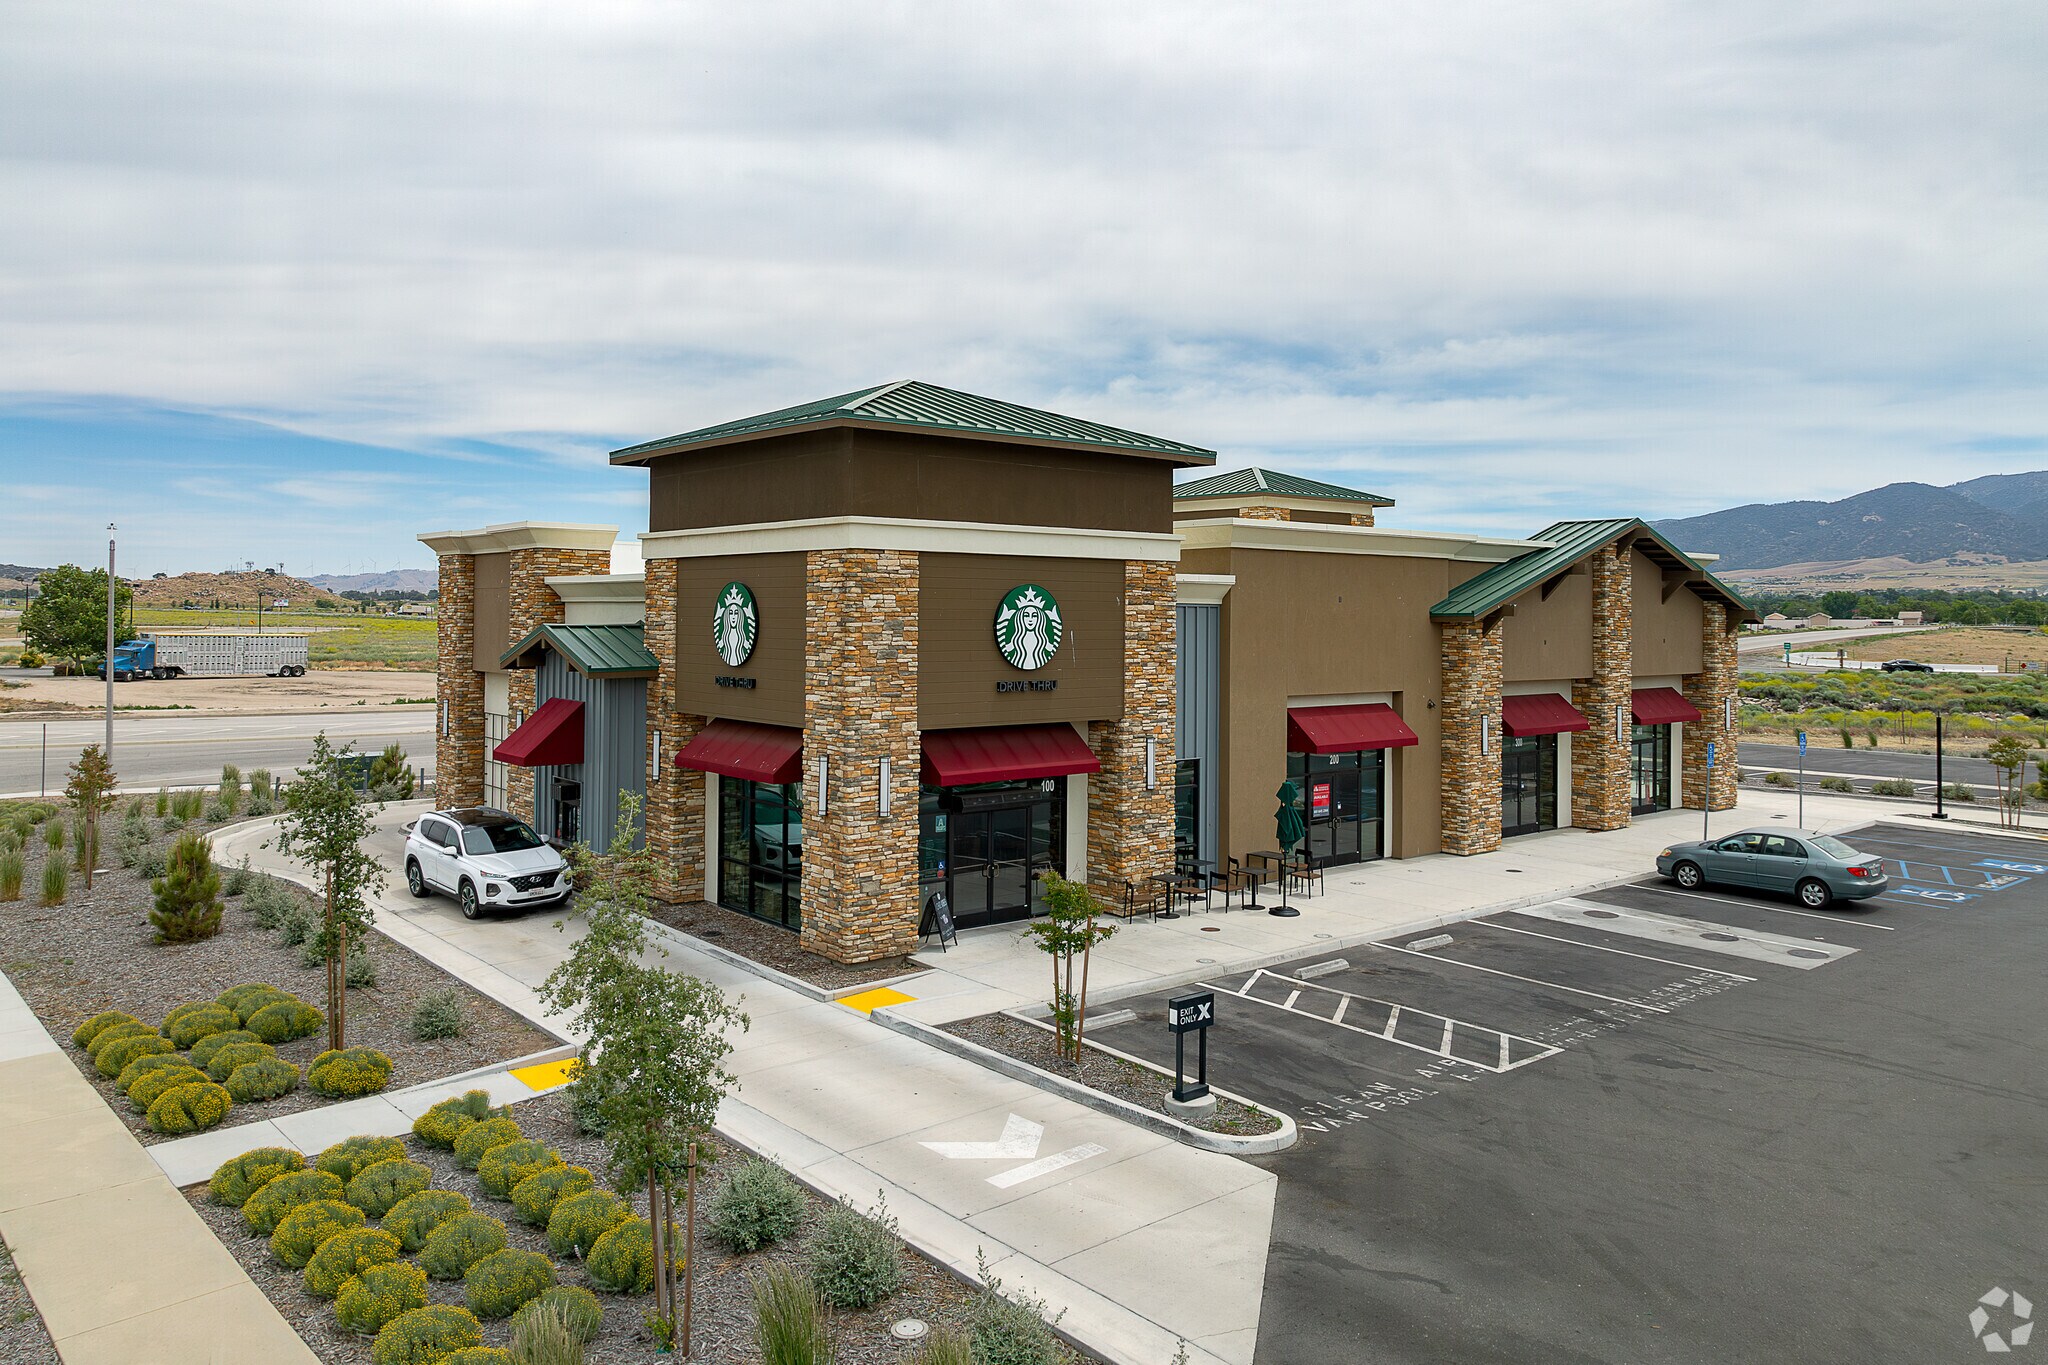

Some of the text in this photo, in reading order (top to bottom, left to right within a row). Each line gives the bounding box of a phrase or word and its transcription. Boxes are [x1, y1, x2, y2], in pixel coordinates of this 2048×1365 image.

[715, 676, 755, 689] DRIVE THRU
[998, 679, 1058, 692] DRIVE THRU
[1329, 754, 1340, 765] 200
[1040, 779, 1055, 792] 100
[1180, 1006, 1194, 1017] EXIT
[1180, 1014, 1197, 1025] ONLY
[1300, 1059, 1467, 1116] CLEAN AIR
